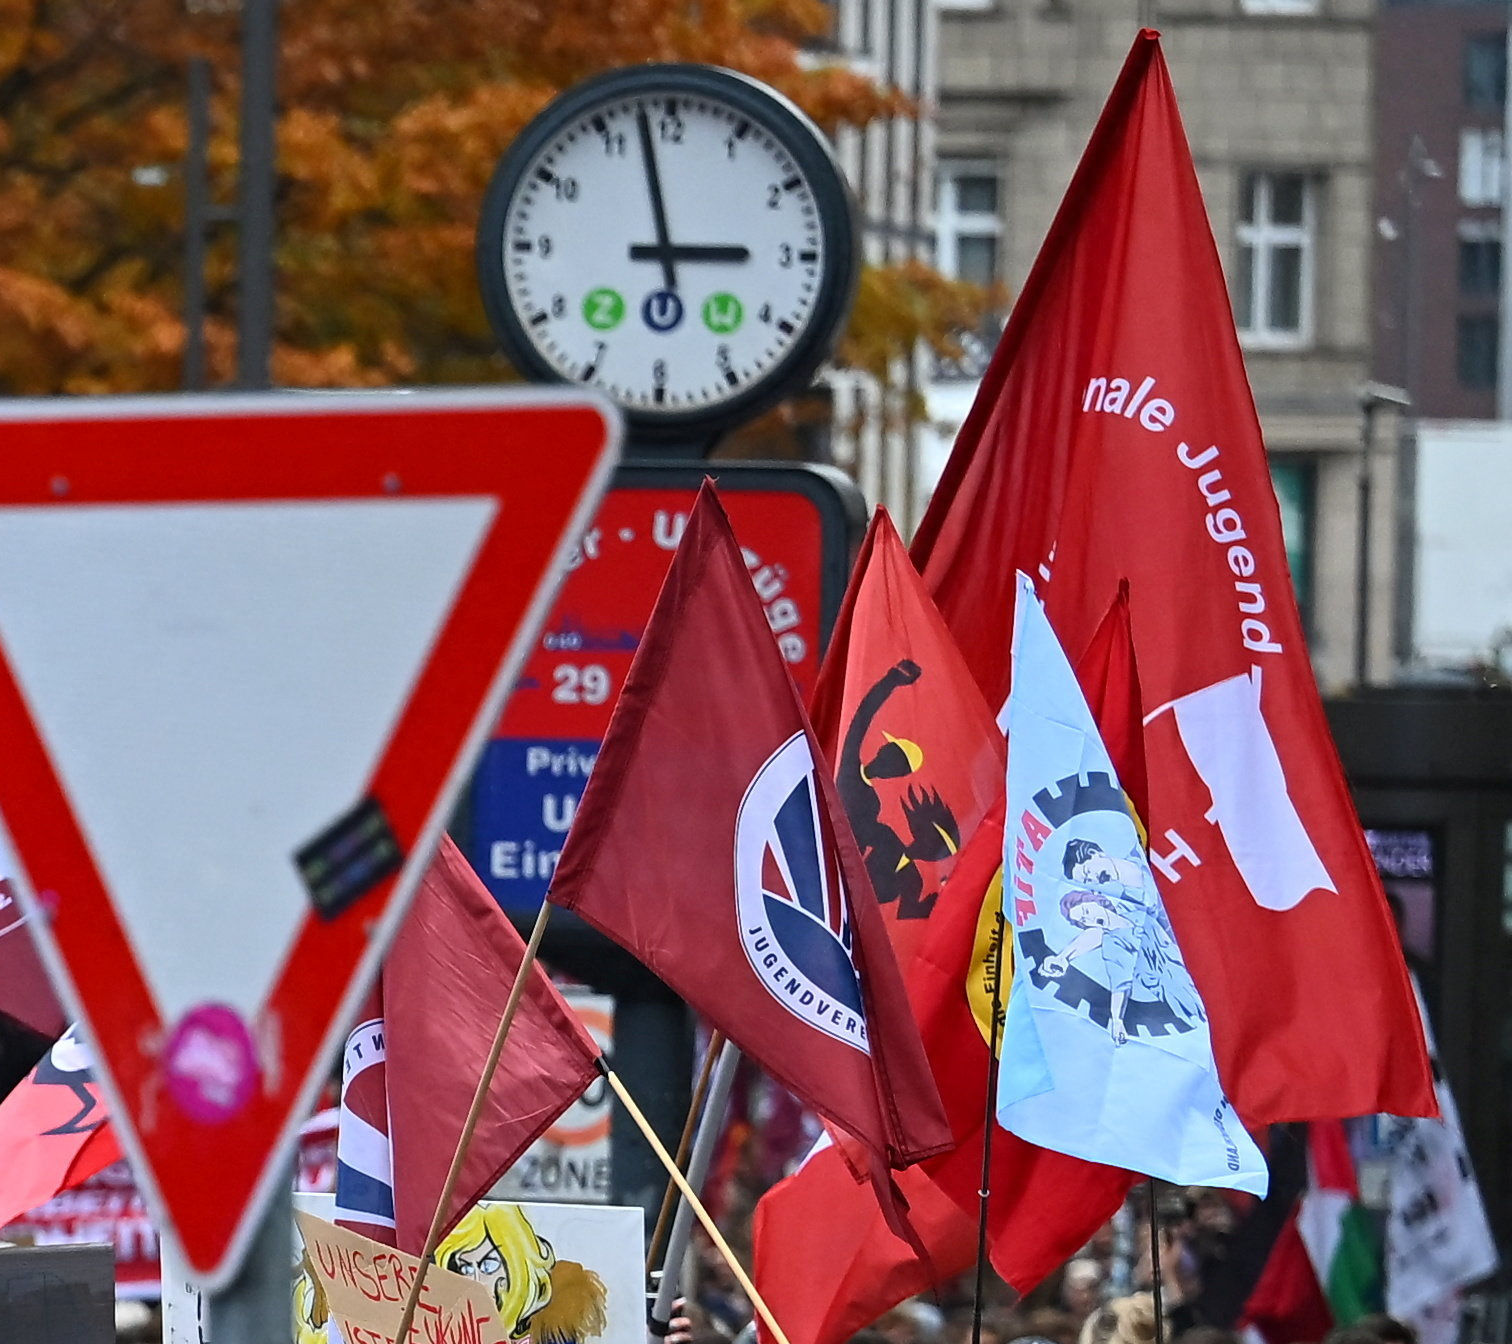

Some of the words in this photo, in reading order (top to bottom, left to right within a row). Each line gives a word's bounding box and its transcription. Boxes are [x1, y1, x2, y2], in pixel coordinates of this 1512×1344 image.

[604, 130, 626, 157] 11
[661, 117, 685, 144] 12
[554, 176, 579, 203] 10
[767, 184, 781, 209] 2
[779, 243, 792, 268] 3
[1081, 376, 1176, 432] nale
[1177, 441, 1283, 654] Jugend
[552, 663, 610, 705] 29
[520, 1154, 610, 1191] ZONE
[314, 1239, 439, 1315] UNSERE
